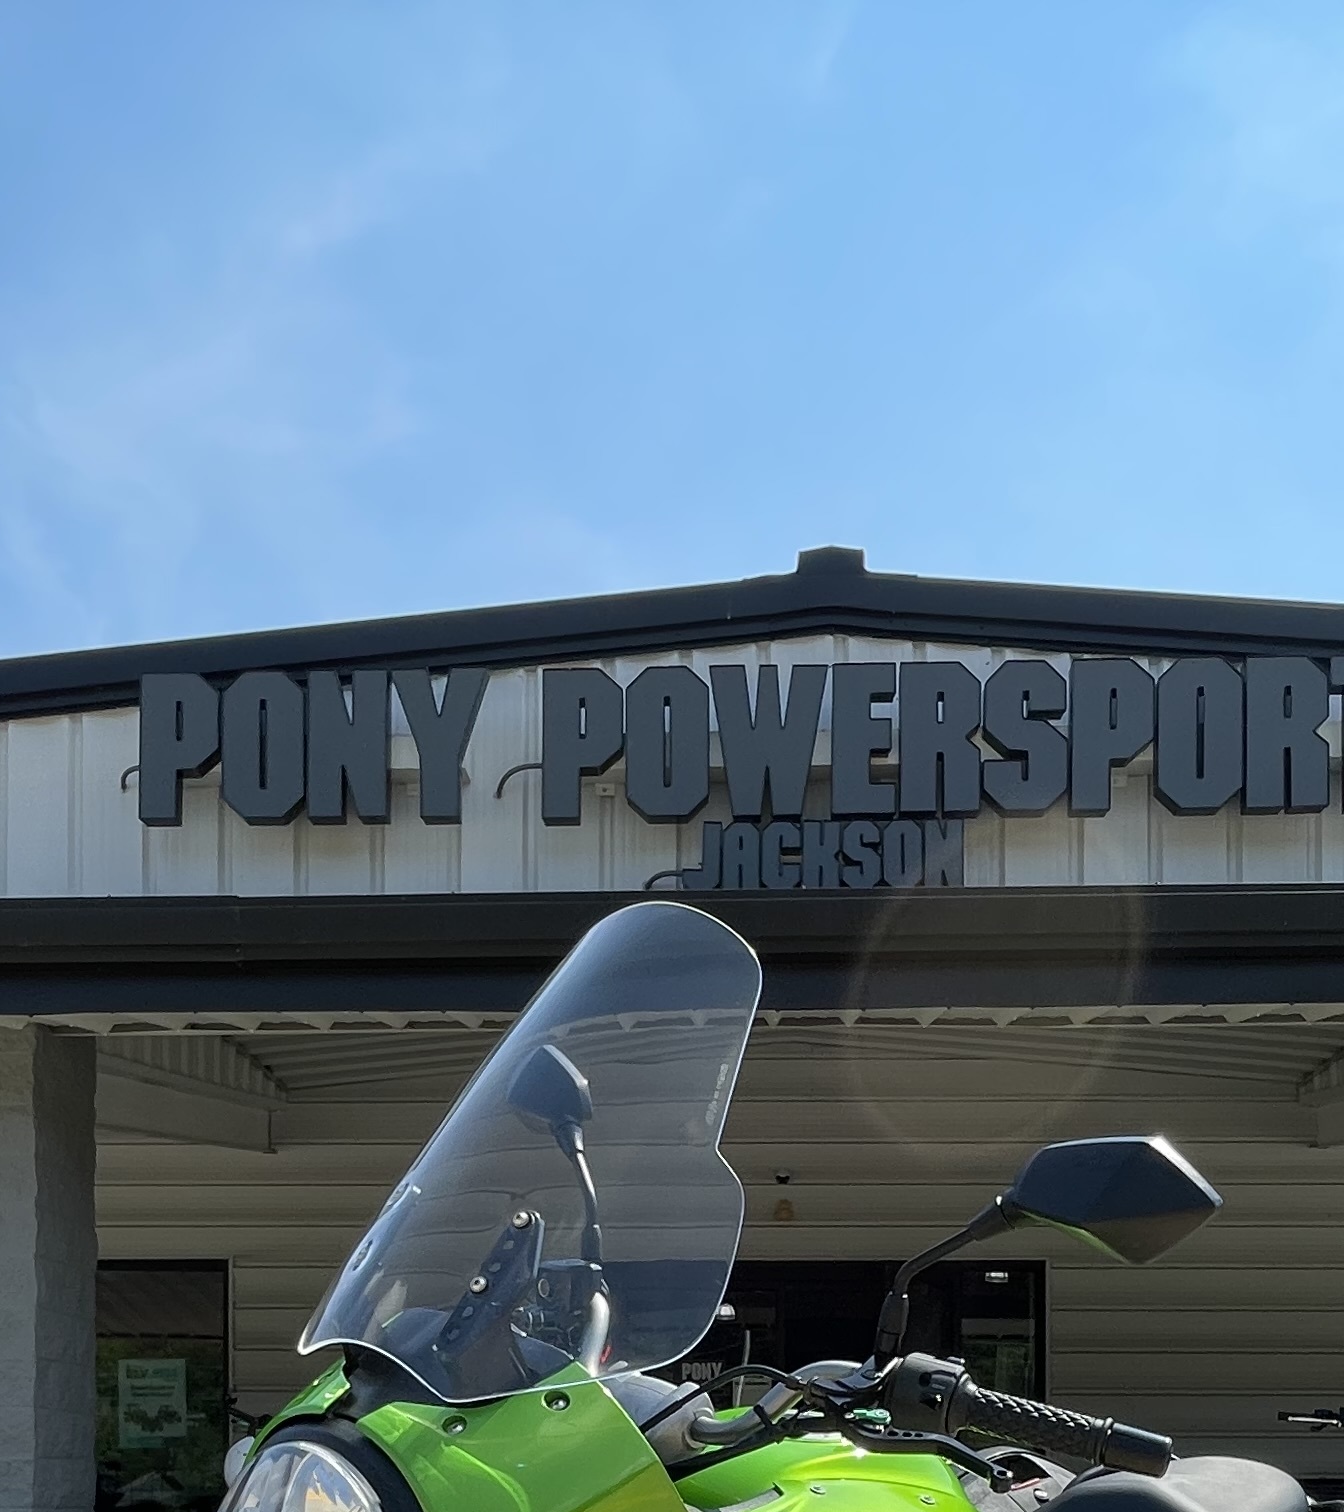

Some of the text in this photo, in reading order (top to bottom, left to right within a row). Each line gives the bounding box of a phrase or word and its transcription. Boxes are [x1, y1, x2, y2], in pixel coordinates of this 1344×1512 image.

[139, 666, 490, 827] PONY
[683, 819, 964, 889] JACKSON
[681, 1361, 723, 1381] PONY
